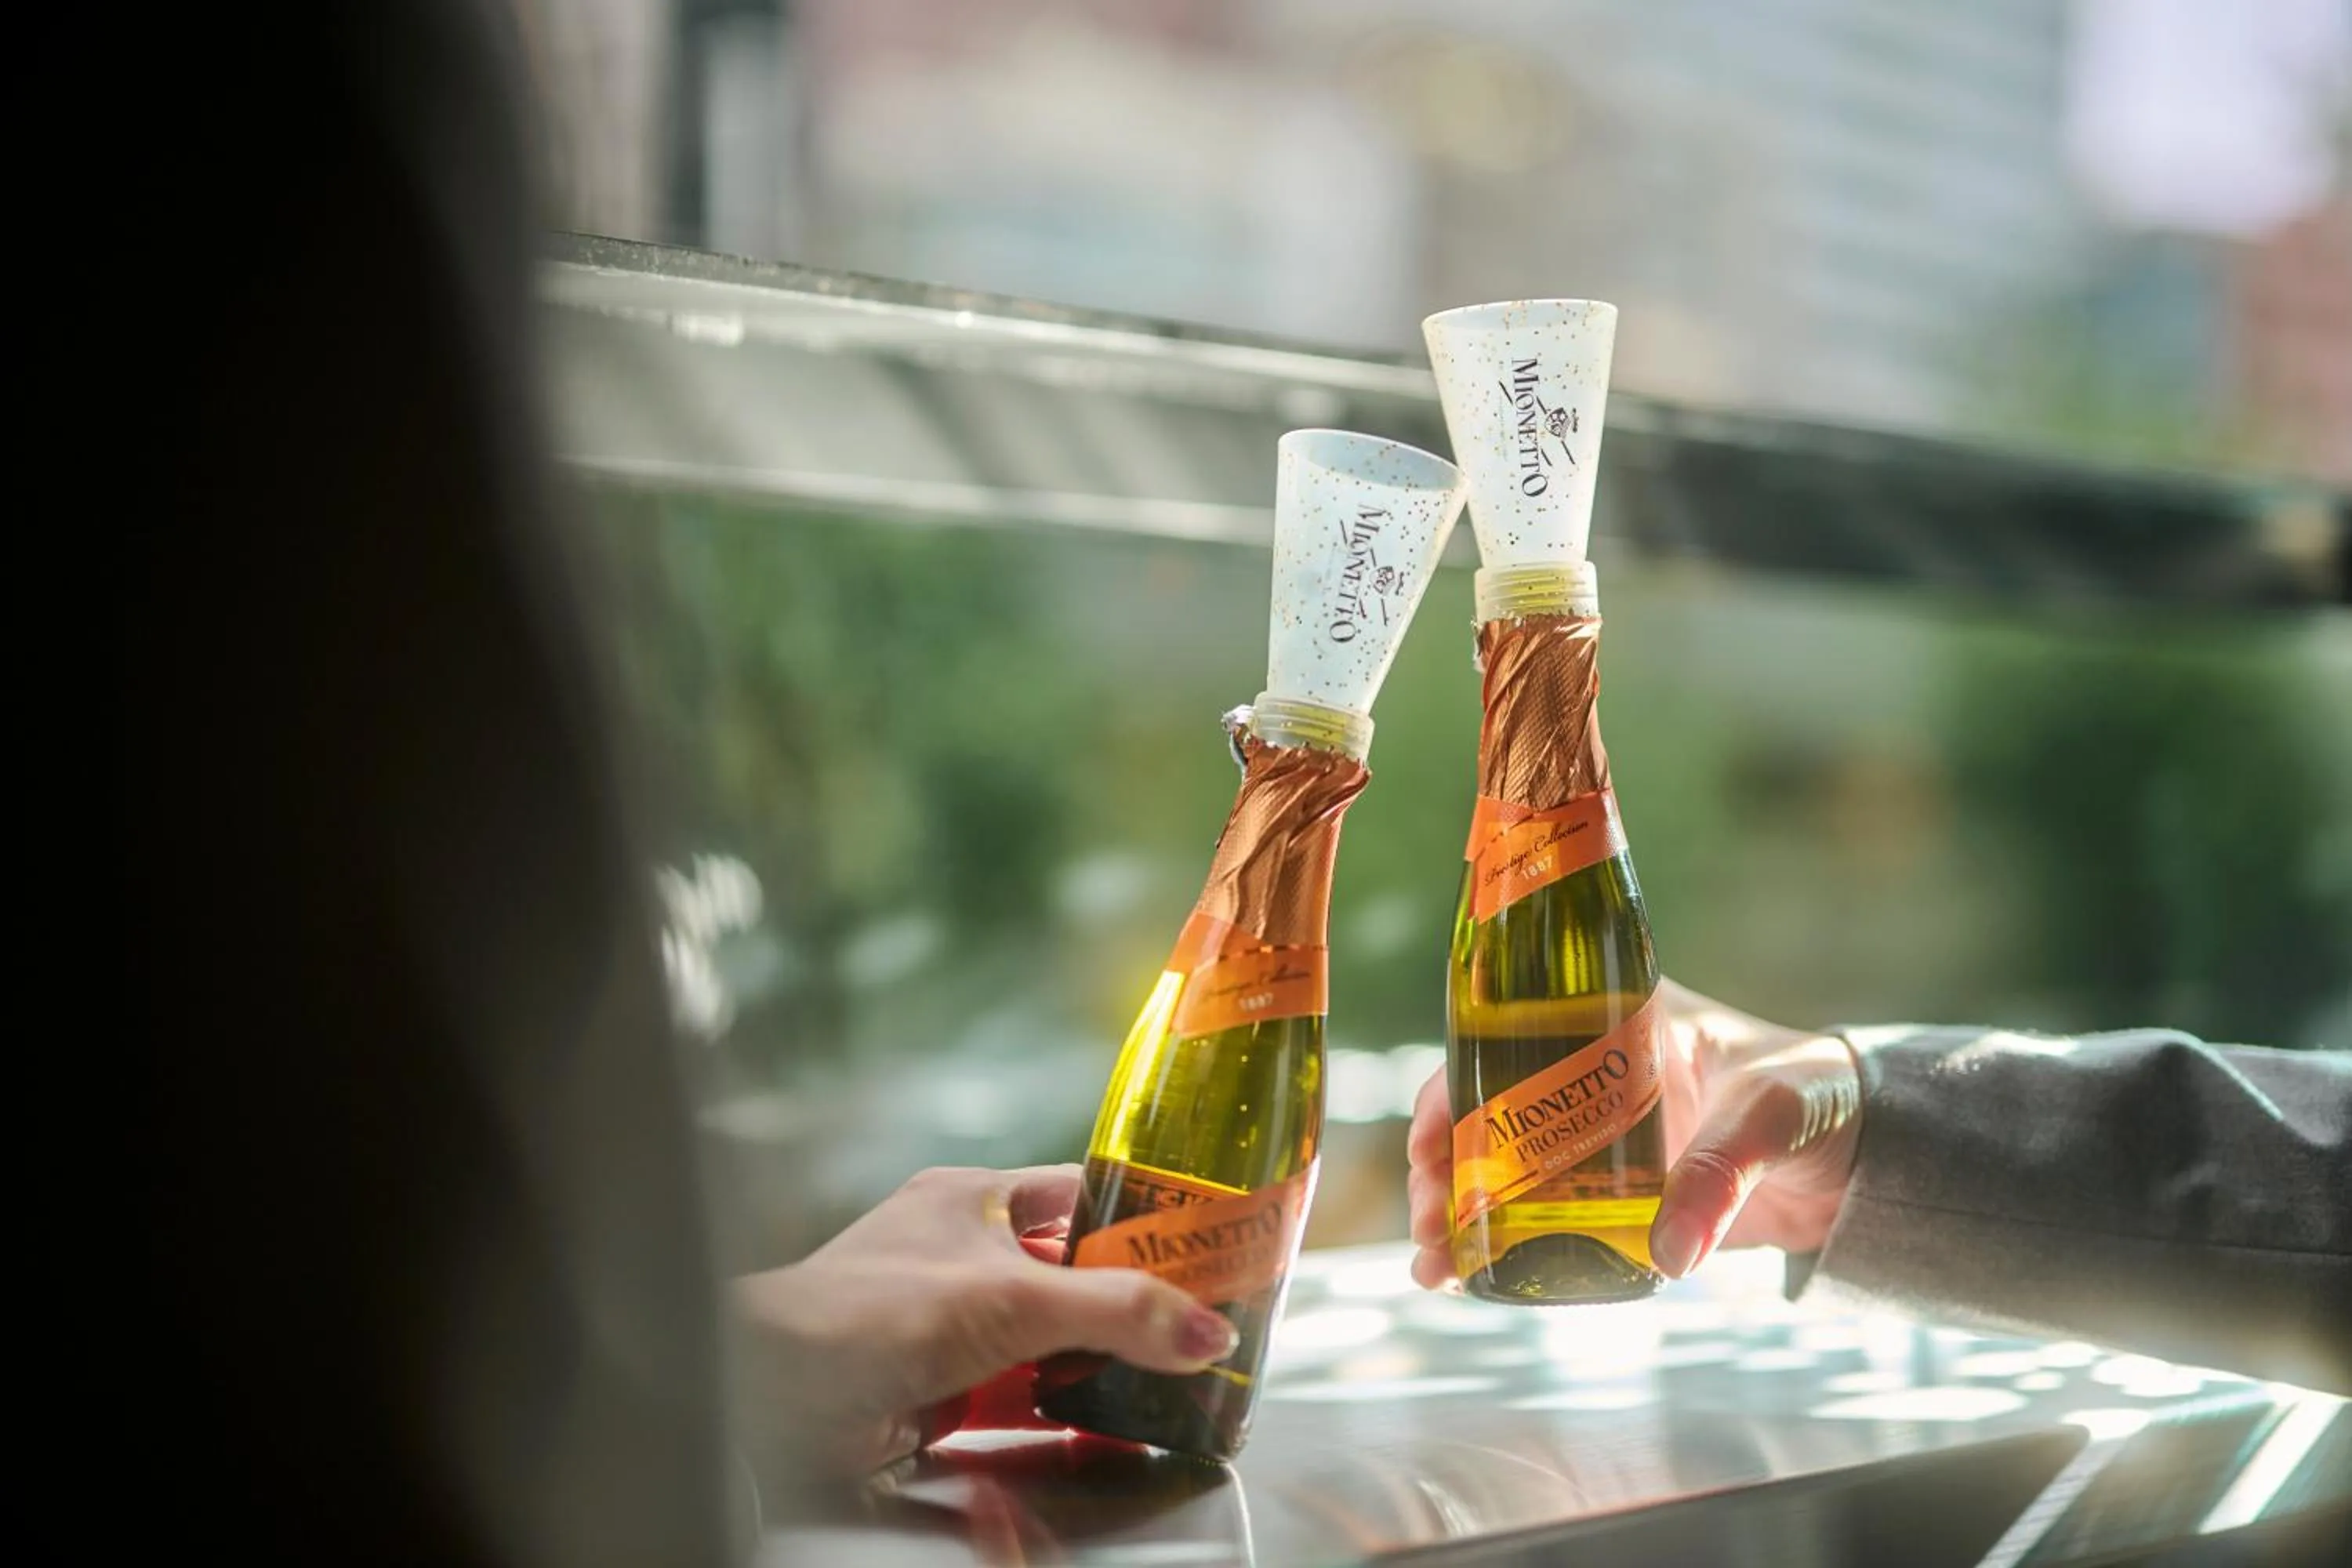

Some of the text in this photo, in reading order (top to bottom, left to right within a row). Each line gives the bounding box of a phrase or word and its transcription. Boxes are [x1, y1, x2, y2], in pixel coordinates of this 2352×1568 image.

[1511, 358, 1548, 498] MIONETTO
[1329, 504, 1386, 643] MIONETTO
[1522, 855, 1554, 880] 1887
[1484, 1048, 1629, 1149] MIONETTO
[1515, 1091, 1624, 1163] PROSECCO
